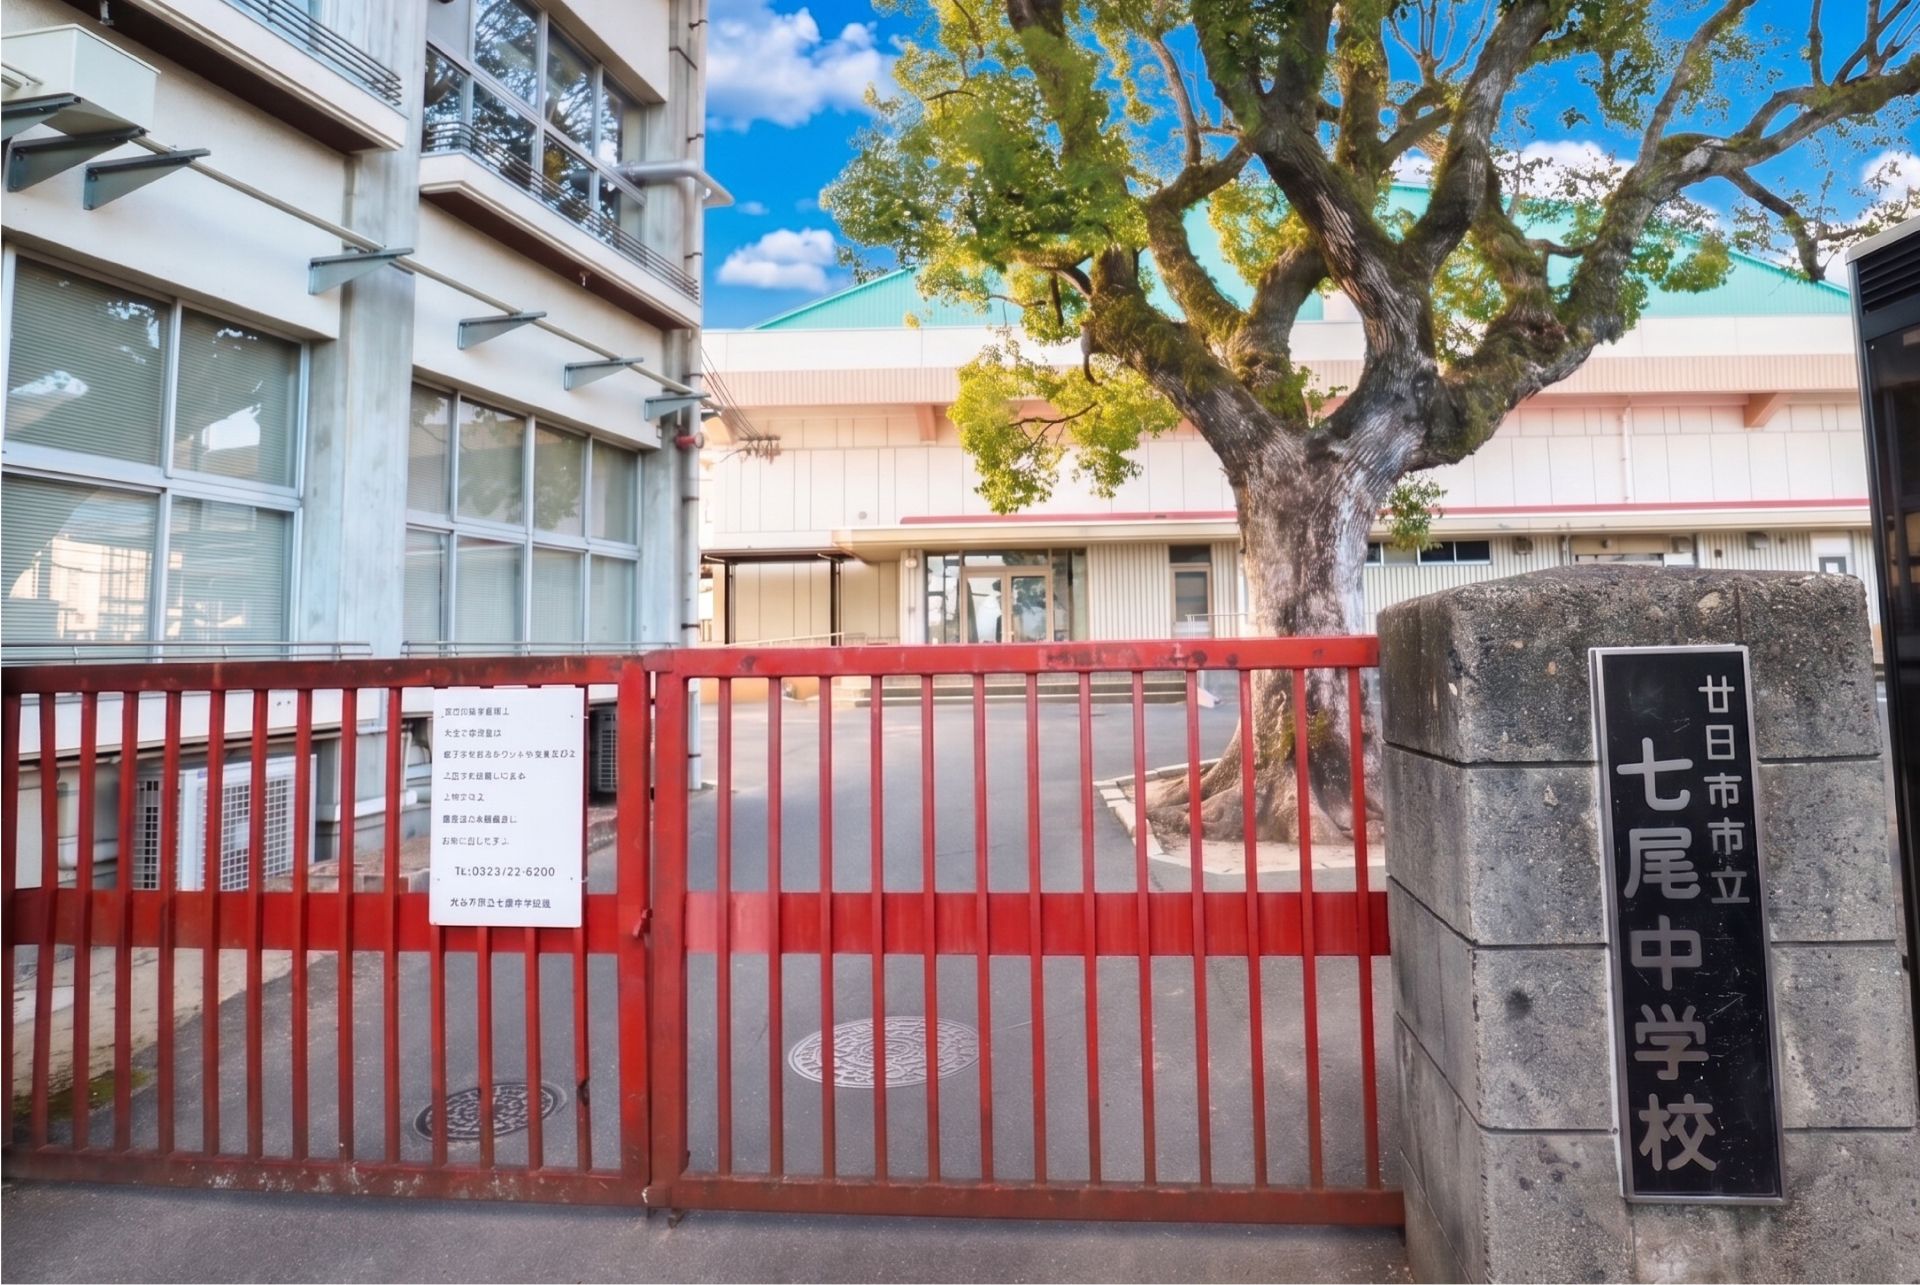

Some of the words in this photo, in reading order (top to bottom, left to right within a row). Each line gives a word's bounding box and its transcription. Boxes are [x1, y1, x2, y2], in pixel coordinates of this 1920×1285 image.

[1616, 737, 1718, 1172] 七尾中学校
[1698, 674, 1750, 904] 廿日市市立
